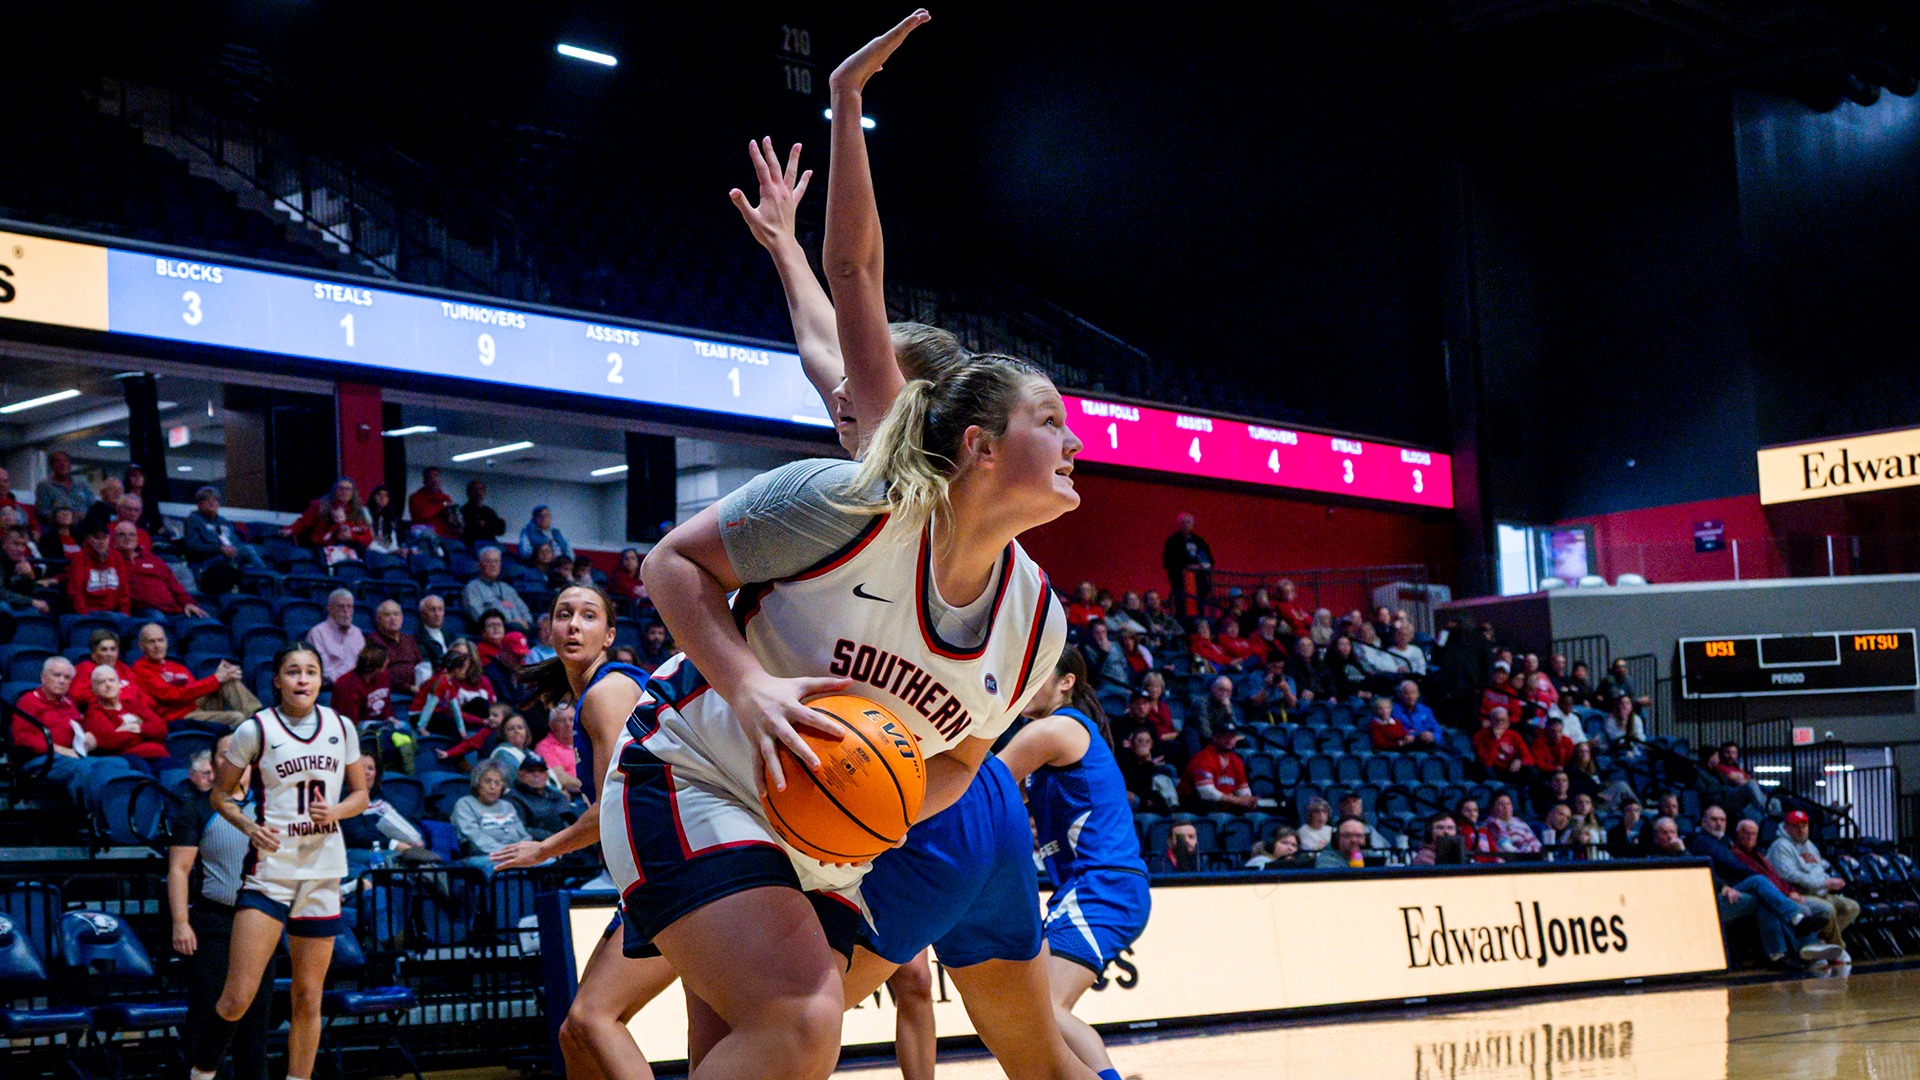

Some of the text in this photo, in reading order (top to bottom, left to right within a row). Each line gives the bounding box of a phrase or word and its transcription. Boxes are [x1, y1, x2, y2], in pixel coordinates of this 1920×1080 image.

[781, 25, 811, 56] 210
[782, 64, 812, 95] 110
[155, 258, 224, 285] BLOCKS
[182, 290, 204, 326] 3
[313, 282, 373, 308] STEALS
[440, 301, 527, 330] TURNOVERS
[339, 313, 355, 347] 1
[585, 324, 641, 347] ASSISTS
[477, 333, 496, 367] 9
[693, 340, 770, 367] TEAM FOULS
[606, 351, 625, 385] 2
[727, 366, 742, 398] 1
[1080, 399, 1141, 422] TEAM FOULS
[1175, 414, 1214, 433] ASSISTS
[1106, 422, 1119, 450] 1
[1247, 424, 1299, 446] TURNOVERS
[1188, 436, 1202, 464] 4
[1267, 447, 1281, 474] 4
[1342, 458, 1355, 484] 3
[1411, 468, 1424, 494] 3
[1705, 634, 1899, 658] USI MTSU
[829, 638, 973, 743] SOUTHERN
[275, 755, 340, 779] SOUTHERN
[287, 821, 339, 838] INDIANA
